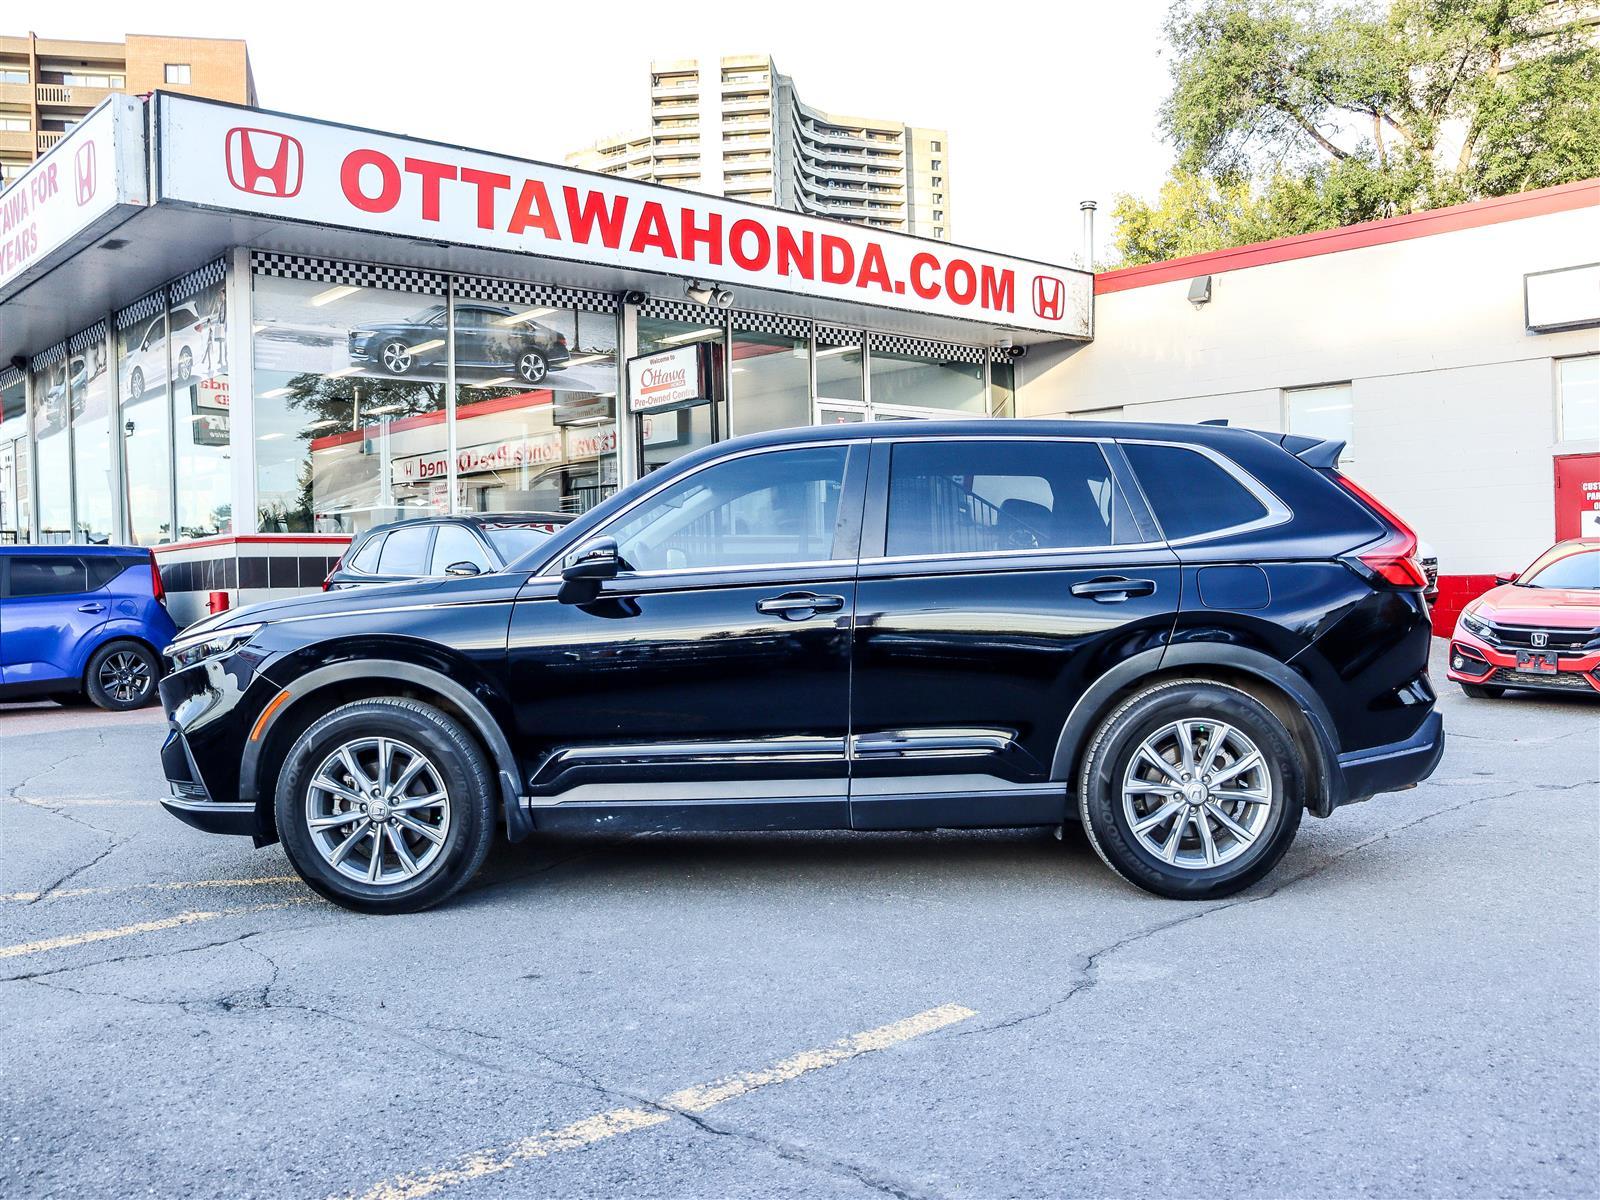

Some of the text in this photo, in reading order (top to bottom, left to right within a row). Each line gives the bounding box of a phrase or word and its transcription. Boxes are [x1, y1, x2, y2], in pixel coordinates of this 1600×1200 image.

[0, 162, 58, 236] AWA FOR
[0, 222, 37, 276] YEARS
[340, 149, 1016, 316] OTTAWAHONDA.COM
[634, 389, 695, 408] Pre-Owned Centre
[640, 368, 686, 388] Ottawa
